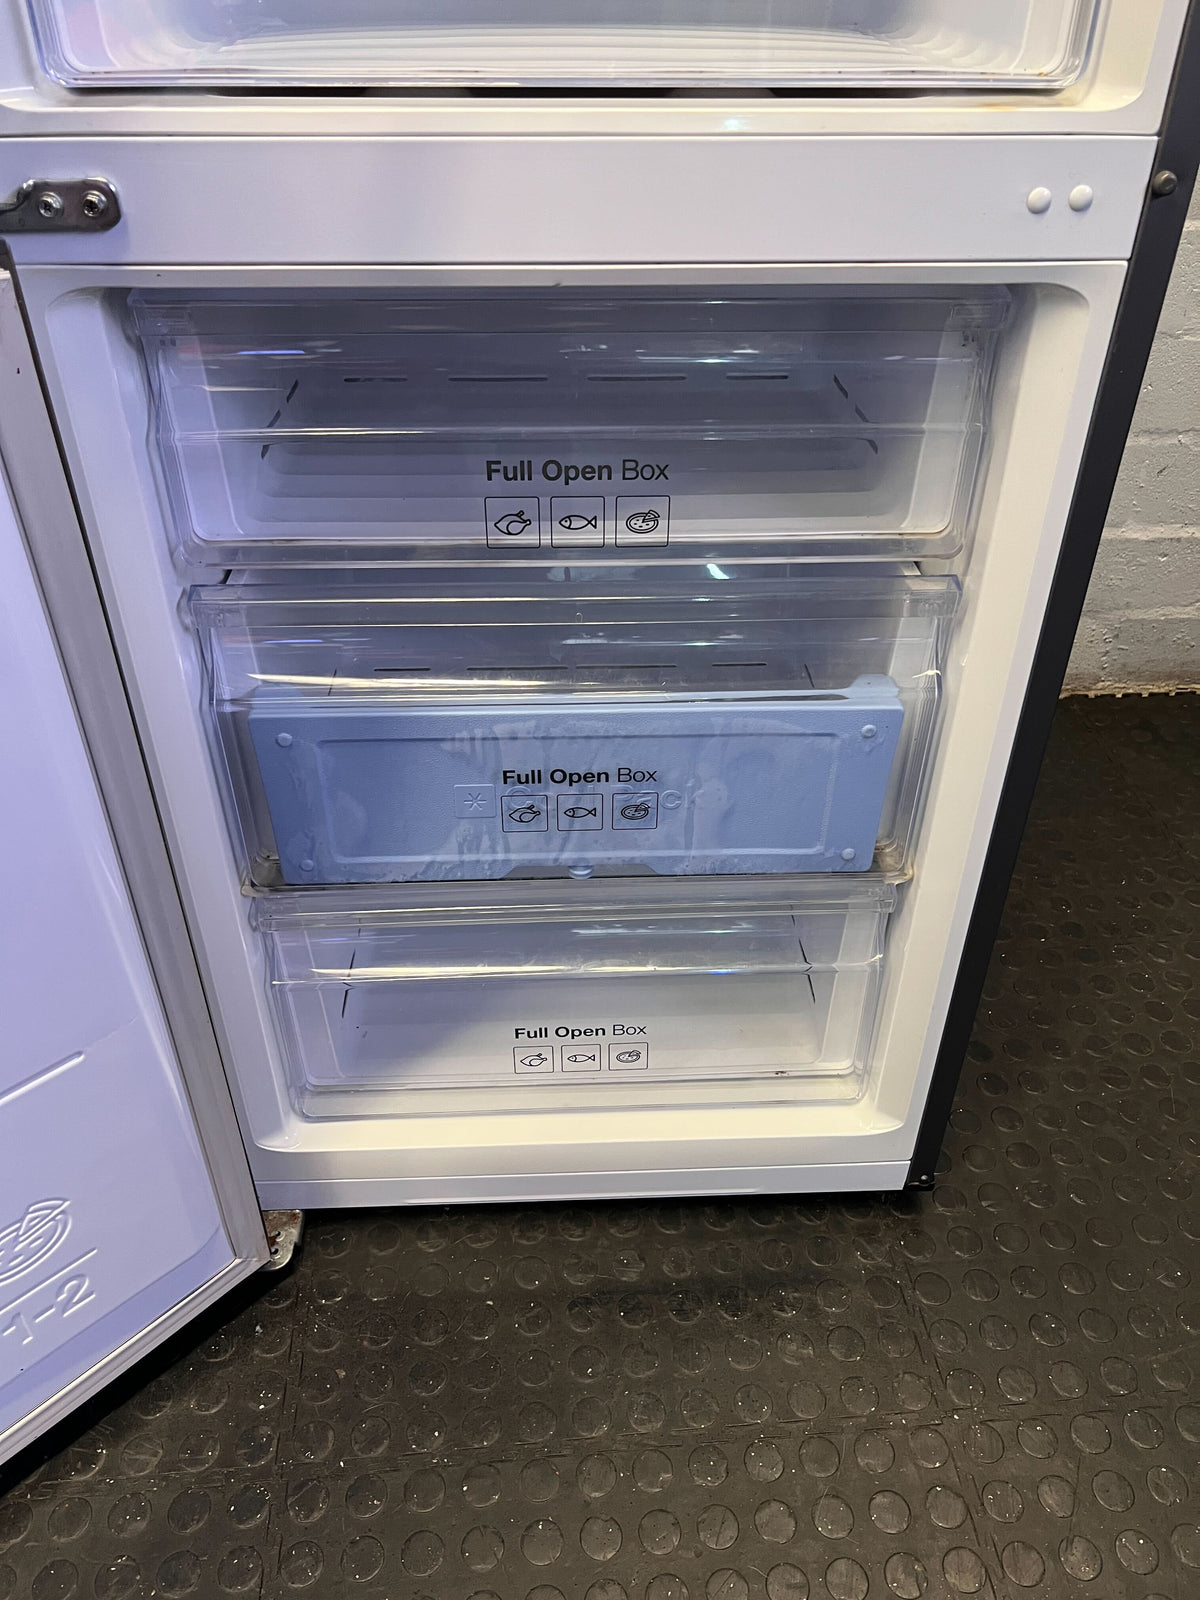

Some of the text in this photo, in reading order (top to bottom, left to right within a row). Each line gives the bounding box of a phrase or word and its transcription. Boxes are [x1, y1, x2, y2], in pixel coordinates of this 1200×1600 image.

[486, 458, 669, 485] Full Open Box
[502, 767, 657, 787] Full Open Box
[514, 1024, 647, 1039] Full Open Box
